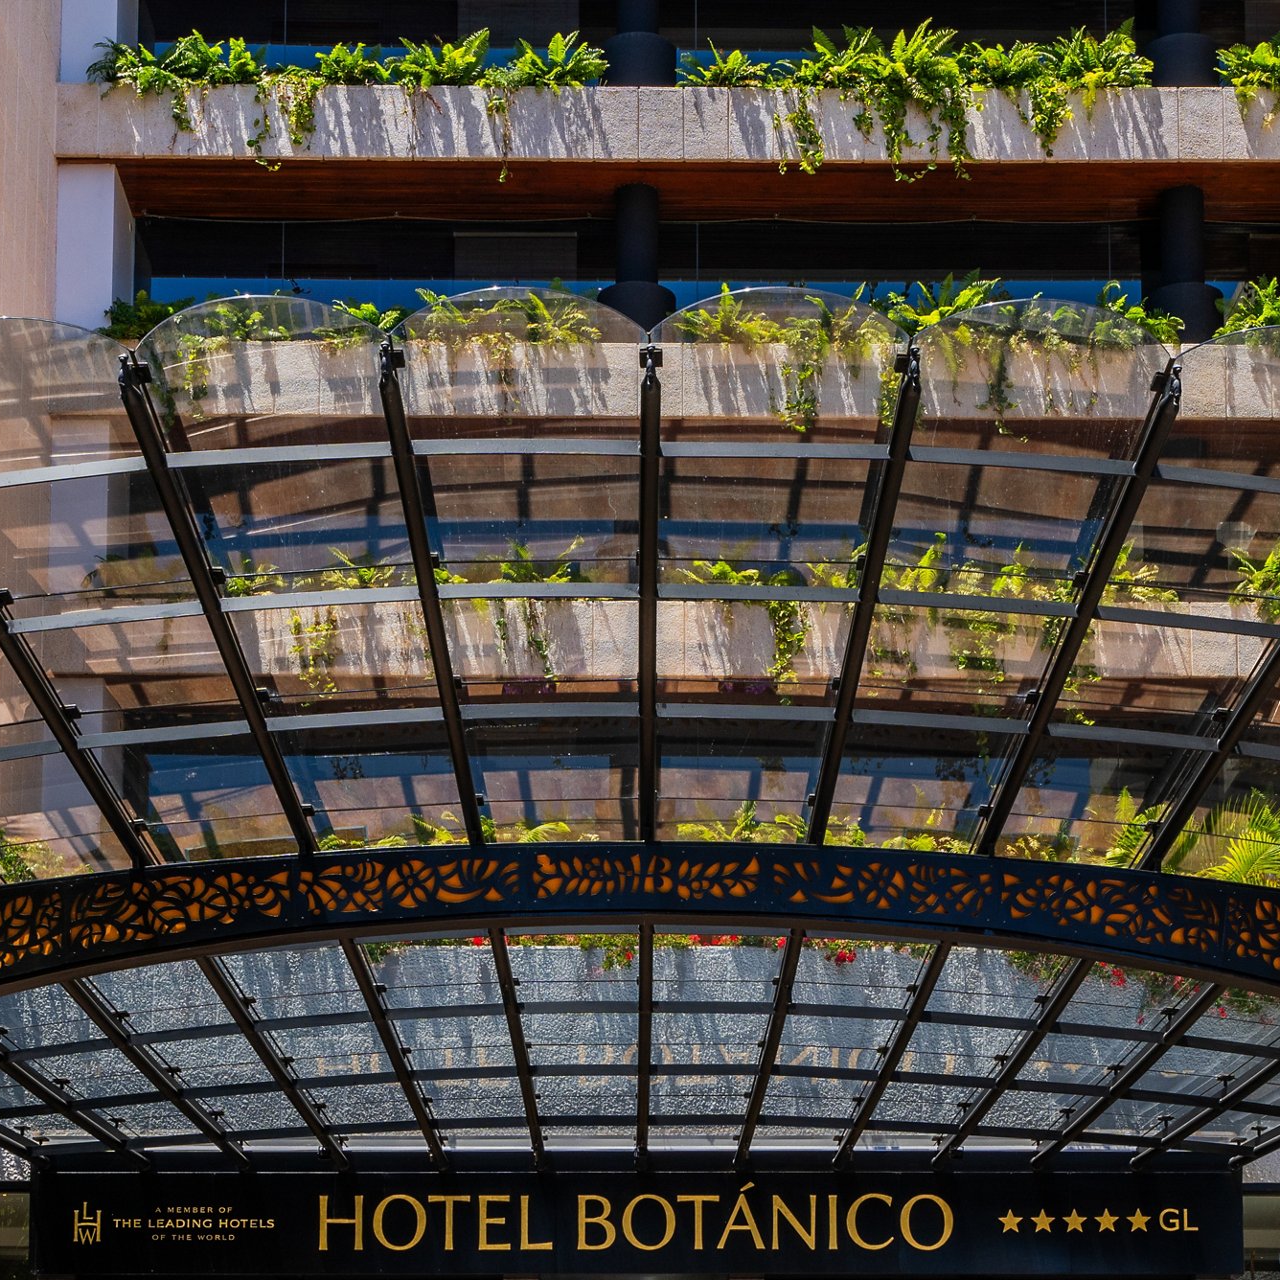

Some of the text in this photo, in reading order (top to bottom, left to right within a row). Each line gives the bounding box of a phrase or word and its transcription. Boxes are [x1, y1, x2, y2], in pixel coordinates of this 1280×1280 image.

[155, 1206, 233, 1214] A MEMBER OF
[319, 1182, 954, 1251] HOTEL BOTÁNICO
[113, 1218, 275, 1228] THE LEADING HOTELS
[1158, 1208, 1199, 1232] GL
